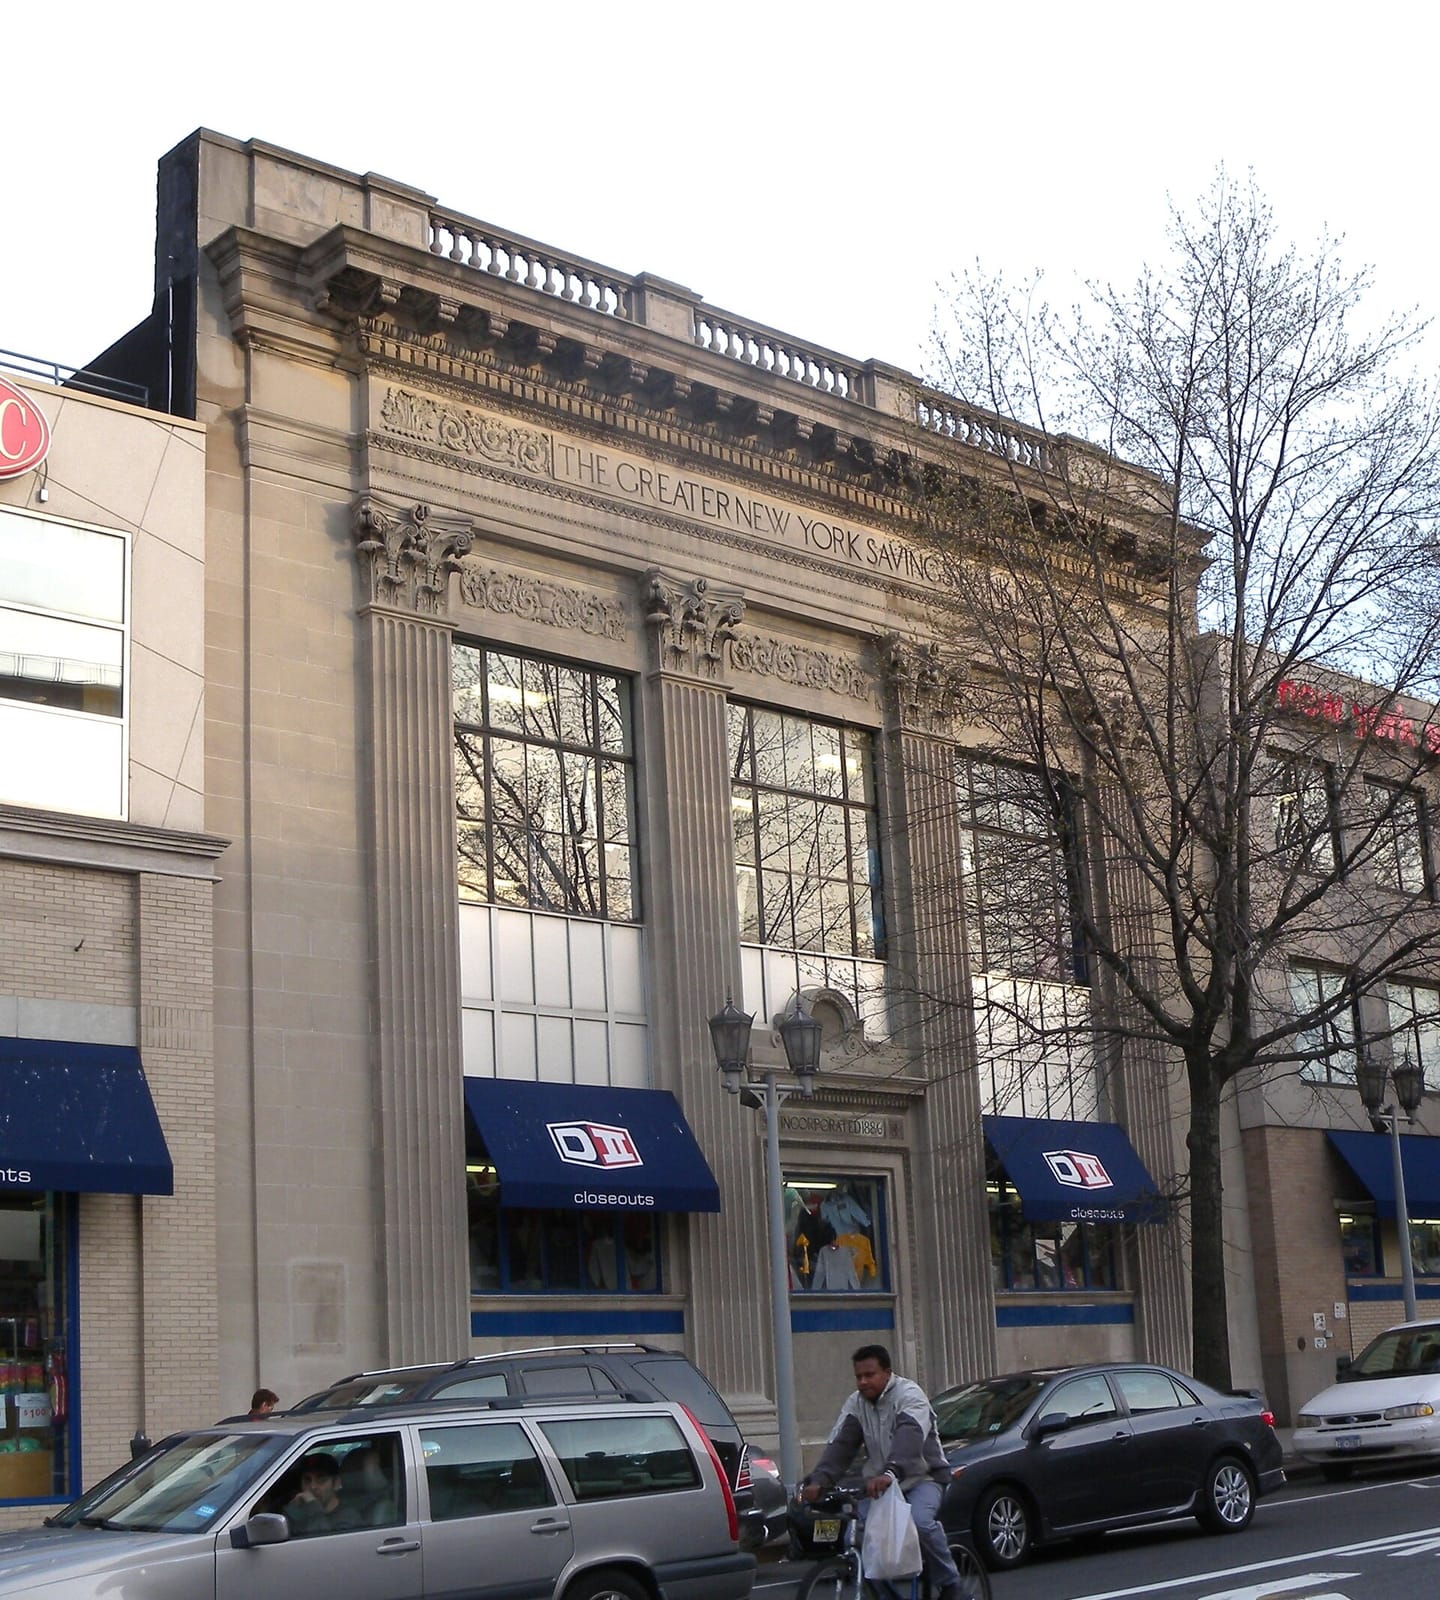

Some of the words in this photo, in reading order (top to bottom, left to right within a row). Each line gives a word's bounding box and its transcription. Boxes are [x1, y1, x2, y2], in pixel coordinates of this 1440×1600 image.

[558, 443, 612, 488] THE
[616, 462, 732, 522] GREATER
[735, 496, 791, 537] NEW
[797, 515, 863, 562] YORK
[781, 1115, 861, 1134] INCORPORATED
[574, 1191, 655, 1206] closeouts
